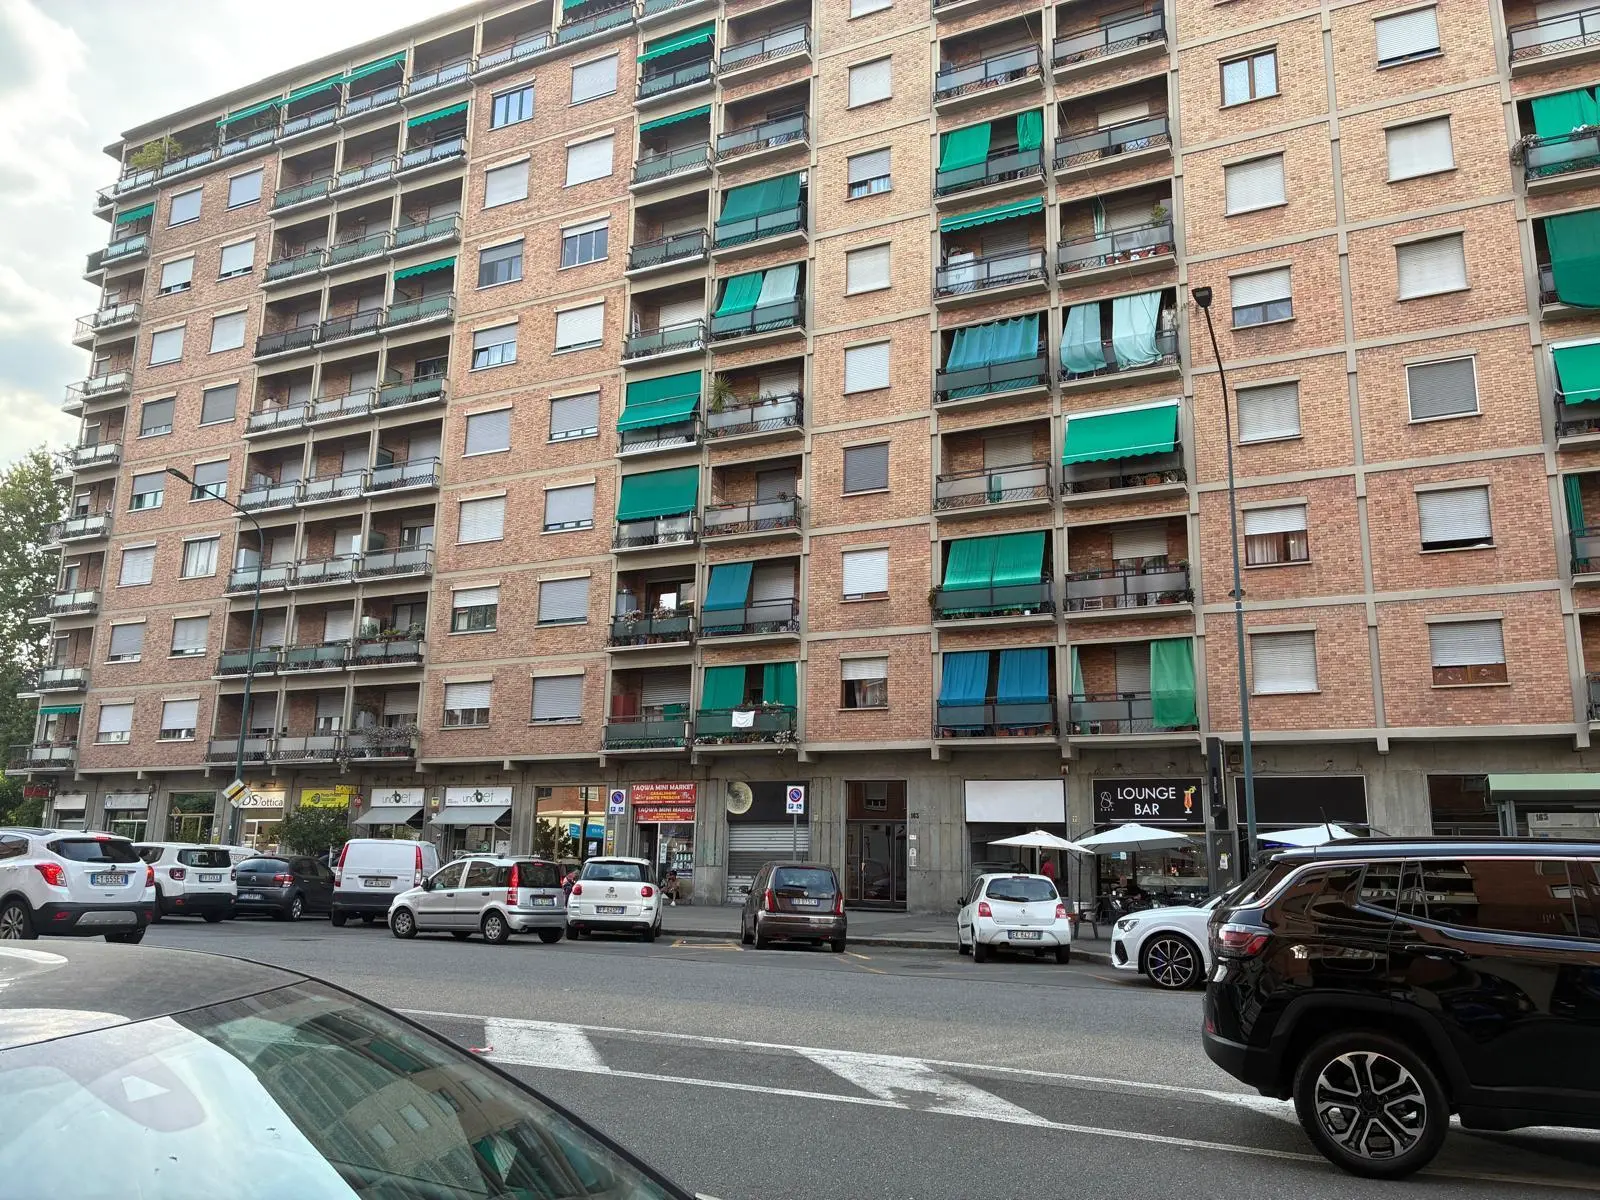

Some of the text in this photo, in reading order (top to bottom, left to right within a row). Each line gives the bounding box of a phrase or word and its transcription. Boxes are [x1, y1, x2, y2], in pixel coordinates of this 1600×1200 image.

[669, 783, 694, 791] MARKET
[1117, 787, 1176, 800] LOUNGE
[261, 798, 284, 806] ottica
[1134, 803, 1160, 816] BAR
